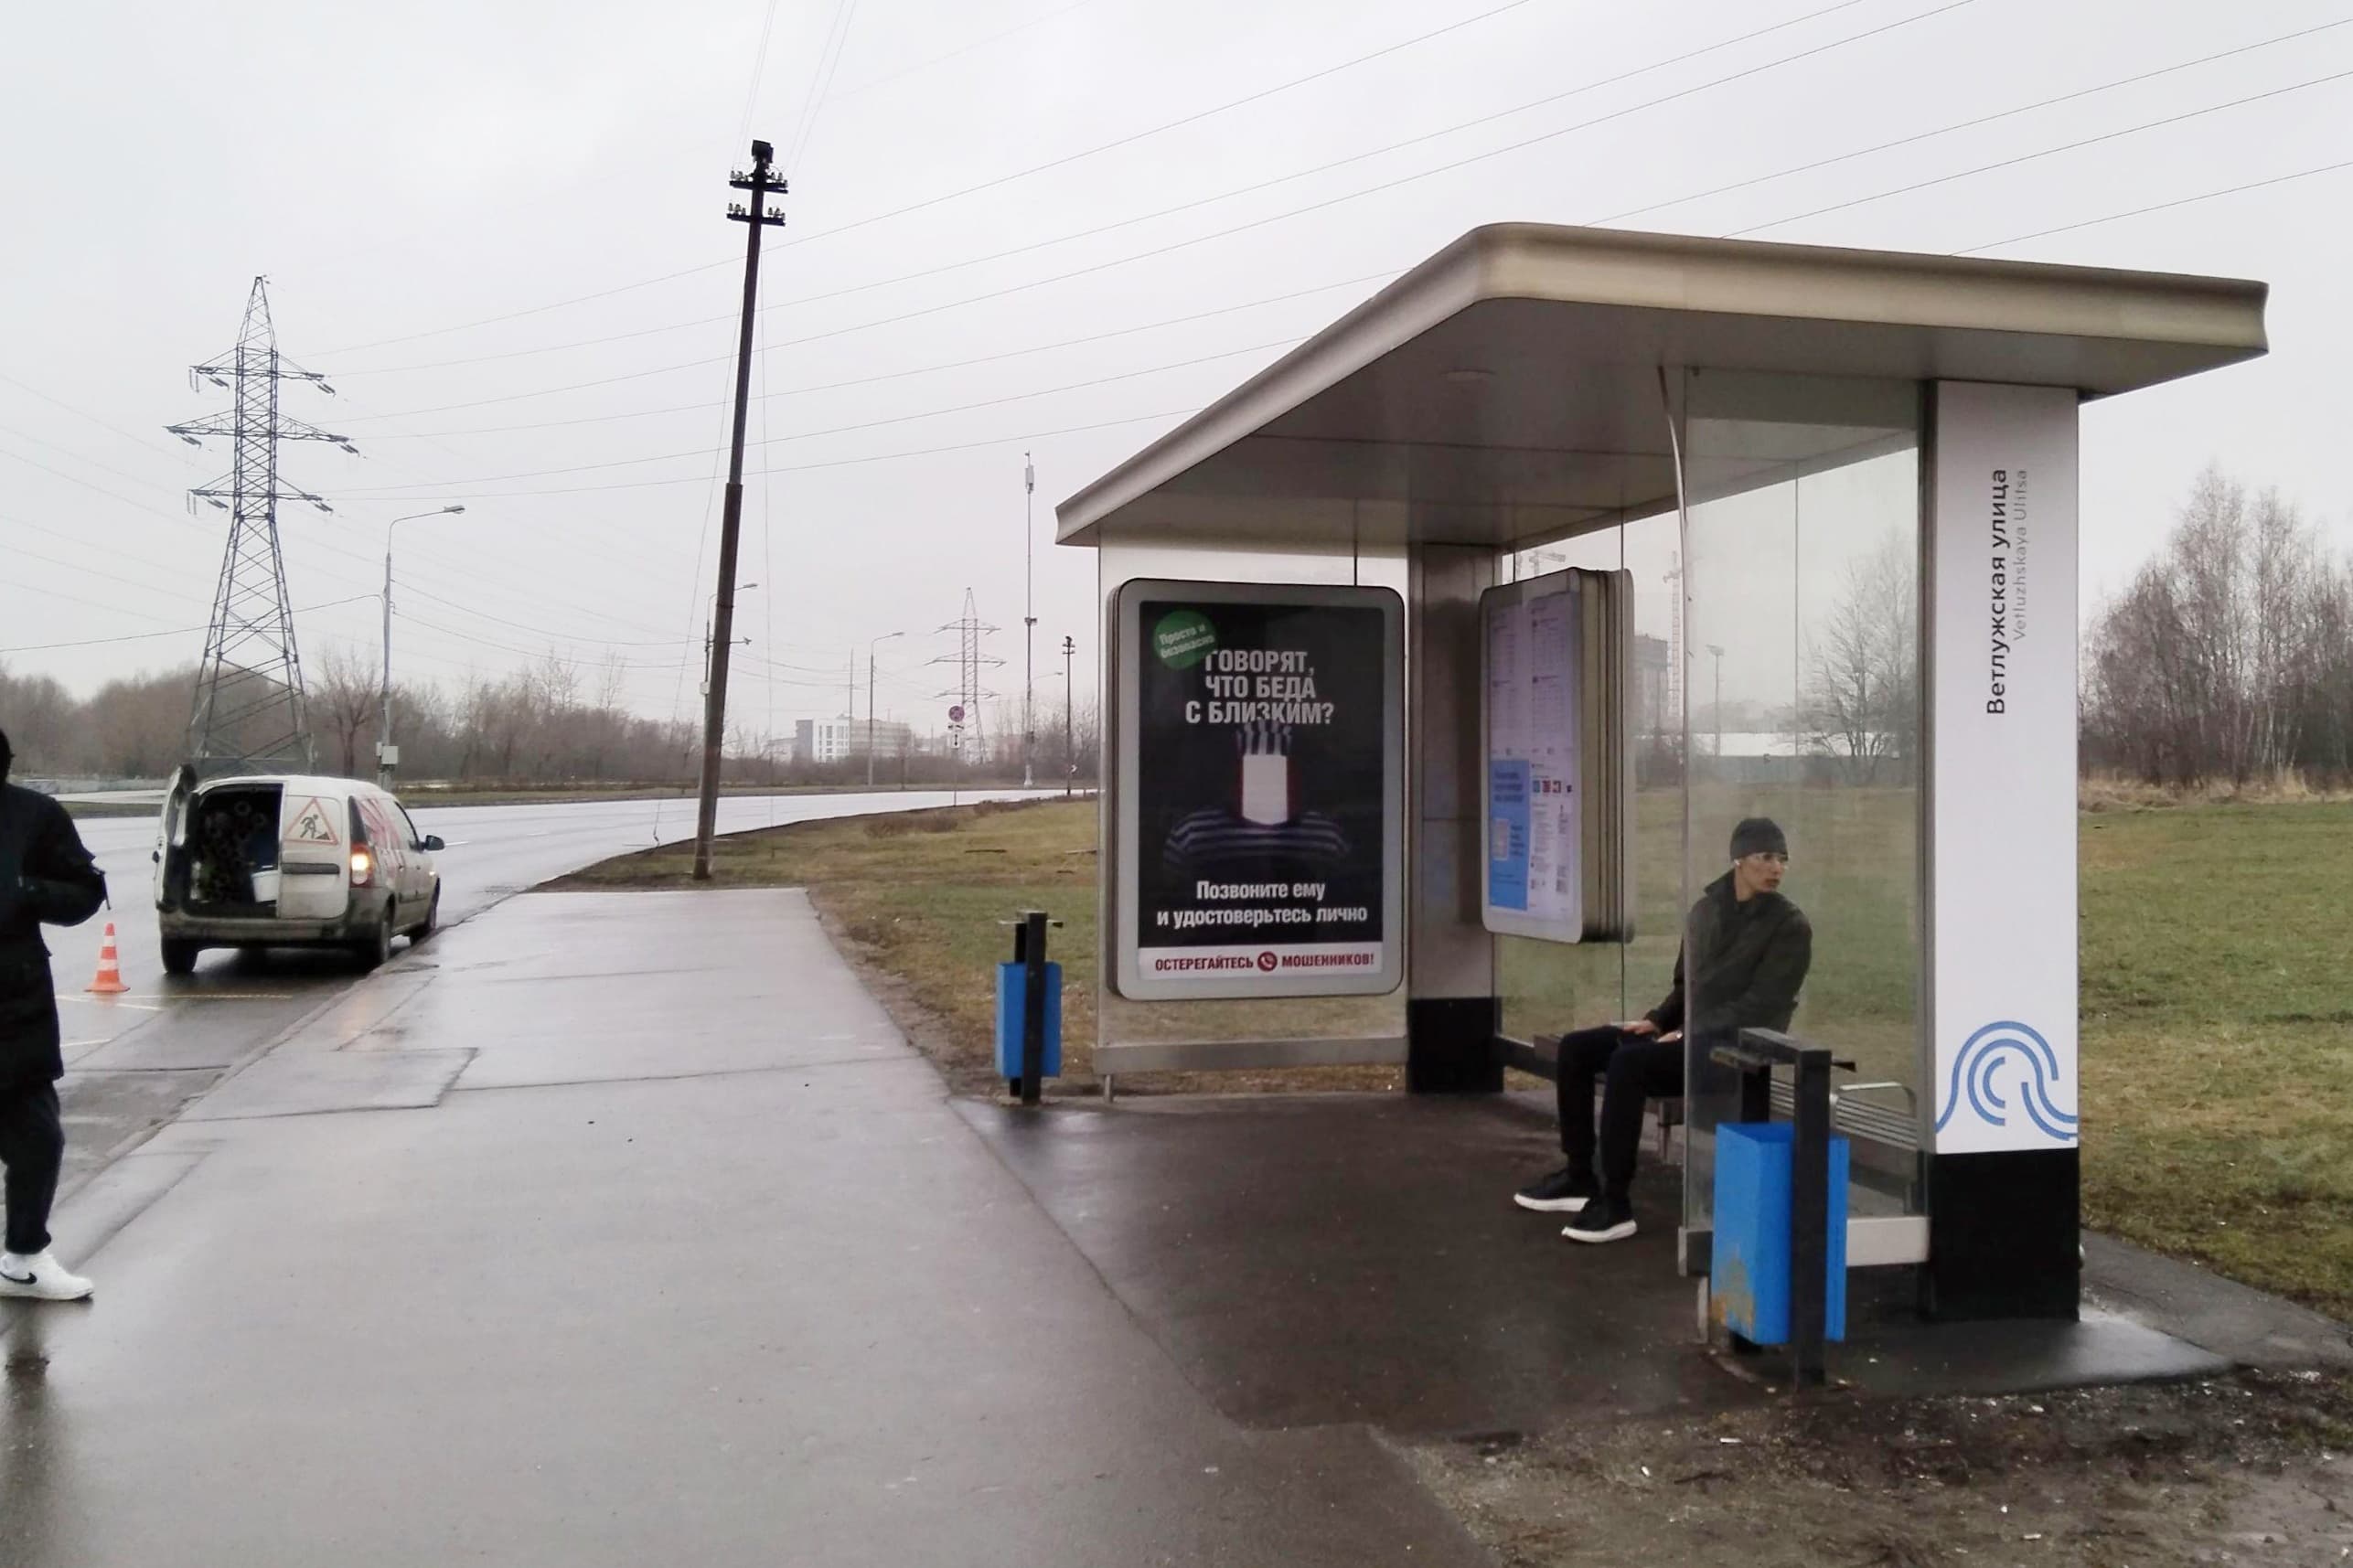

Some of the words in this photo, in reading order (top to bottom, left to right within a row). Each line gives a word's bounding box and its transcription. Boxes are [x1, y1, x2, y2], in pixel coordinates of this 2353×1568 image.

[1992, 468, 2011, 549] улица
[2013, 469, 2027, 521] Ulitsa
[2013, 526, 2030, 641] Vetluzhskaya
[1986, 557, 2010, 715] Ветлужская
[1204, 648, 1315, 676] ГОВОРЯТ,
[1204, 676, 1249, 699] ЧТО
[1256, 676, 1317, 702] БЕДА
[1185, 700, 1202, 724] С
[1208, 701, 1335, 724] БЛИЗКИМ?
[1196, 880, 1289, 901] Позвоните
[1292, 882, 1326, 901] ему
[1156, 912, 1169, 926] и
[1173, 908, 1312, 930] удостоверьтесь
[1315, 906, 1368, 923] лично
[1155, 955, 1254, 972] ОСТЕРЕГАЙТЕСЬ
[1281, 954, 1374, 968] МОШЕННИКОВ!
